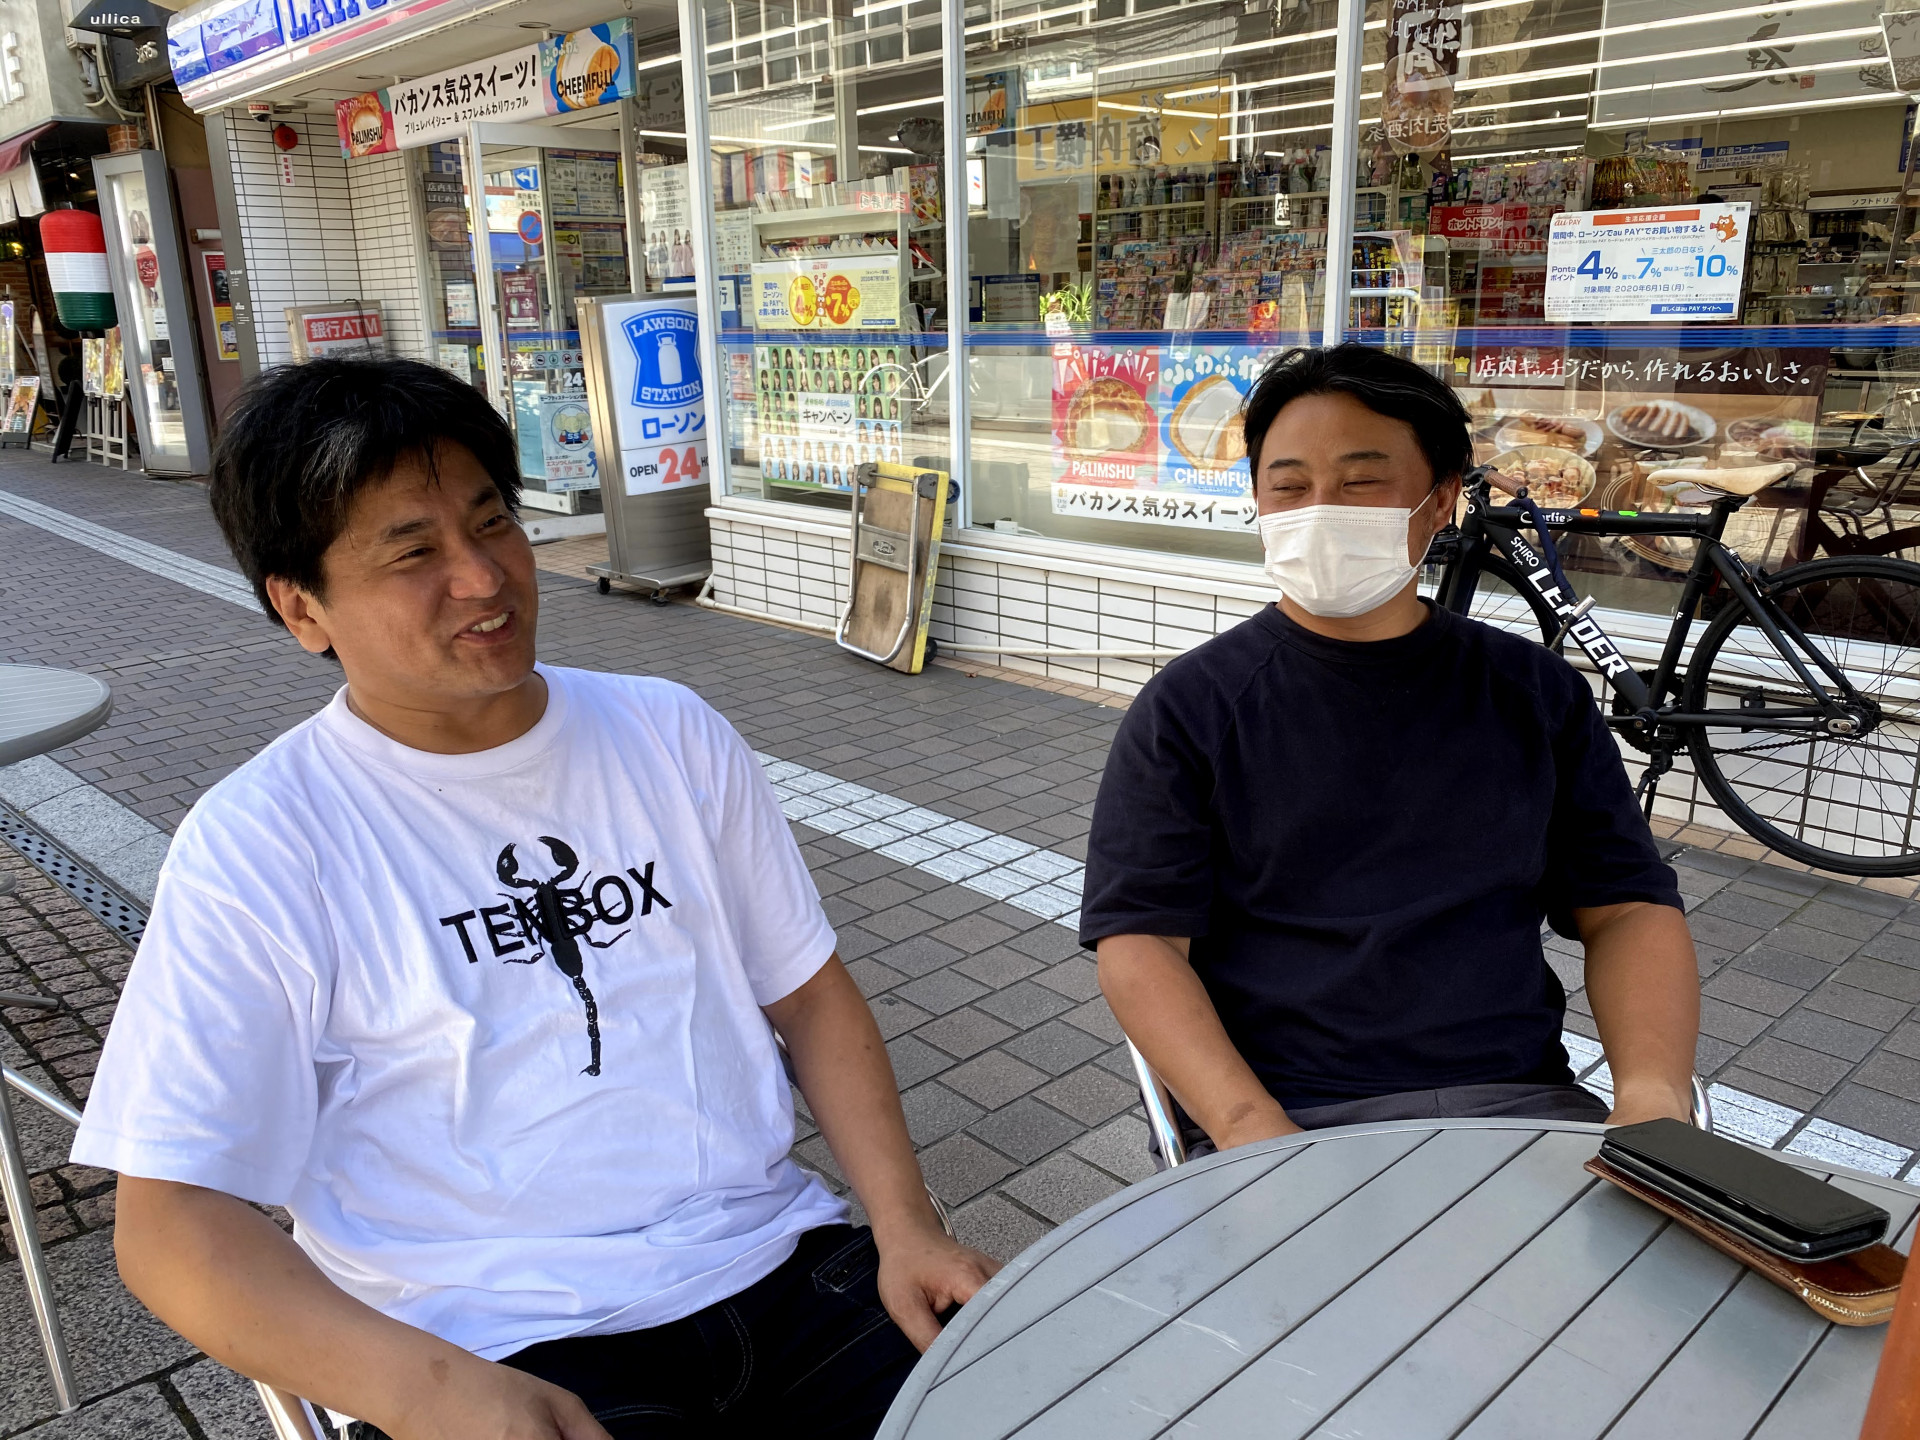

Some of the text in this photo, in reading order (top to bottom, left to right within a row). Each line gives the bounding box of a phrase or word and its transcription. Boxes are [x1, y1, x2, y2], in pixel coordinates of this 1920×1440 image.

[90, 13, 141, 25] ullica
[556, 67, 616, 98] CHEEMFULL
[453, 111, 460, 122] &
[351, 125, 383, 146] PALIMSHU
[1550, 274, 1576, 282] ポイント
[1551, 265, 1576, 273] Ponta
[310, 317, 379, 339] 銀行ATM
[631, 316, 696, 338] LAWSON
[641, 380, 702, 402] STATION
[642, 412, 705, 440] ローソン
[803, 408, 853, 425] キャンペーン
[629, 463, 659, 478] OPEN
[658, 446, 702, 485] 24
[1071, 461, 1136, 481] PALIMSHU
[1510, 536, 1540, 567] SHIRO
[439, 861, 673, 964] TENBOX
